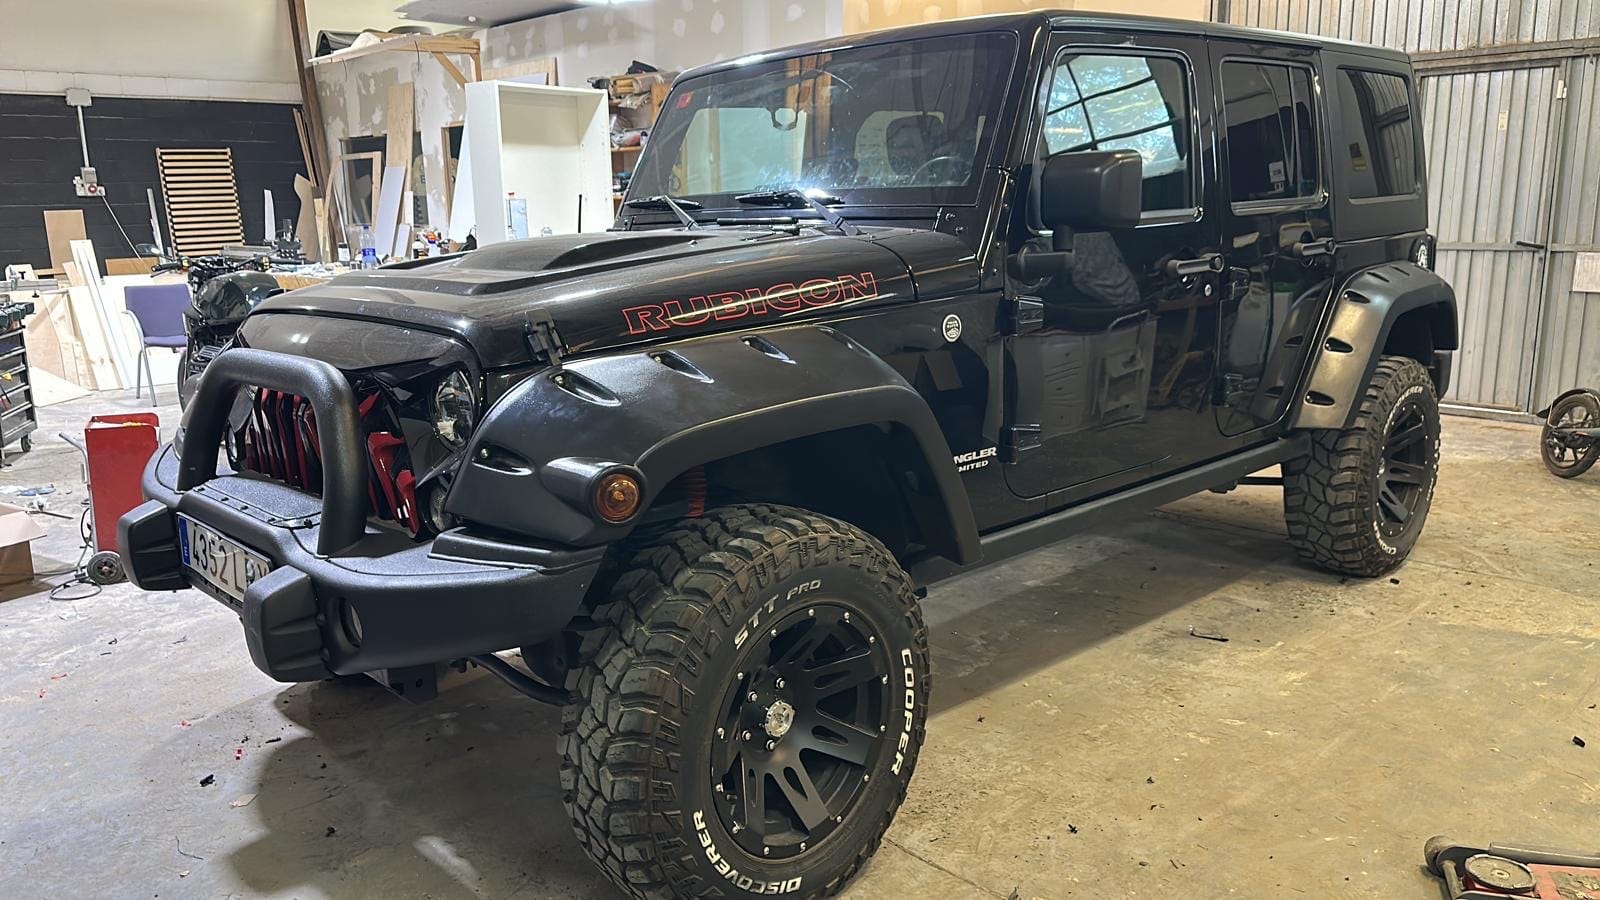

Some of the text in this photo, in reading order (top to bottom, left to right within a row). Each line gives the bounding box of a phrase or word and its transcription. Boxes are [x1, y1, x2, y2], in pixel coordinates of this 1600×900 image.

[620, 272, 878, 335] RUBICON
[953, 446, 997, 465] NGLER
[958, 460, 989, 473] MITED
[192, 529, 229, 586] 4352
[734, 579, 821, 651] STT PRO
[891, 648, 915, 776] COOPER
[693, 809, 803, 895] DISCOVERER
